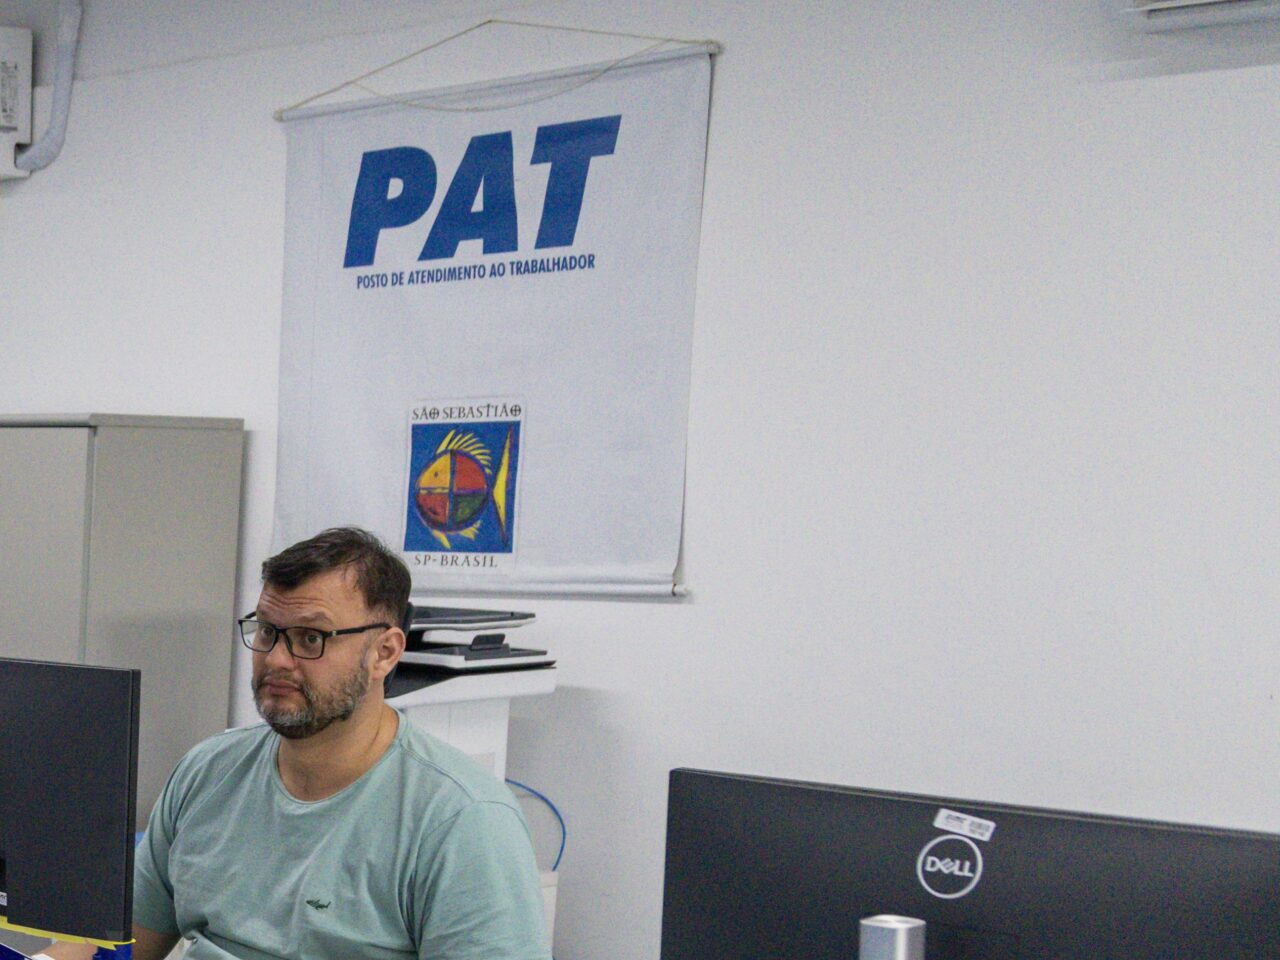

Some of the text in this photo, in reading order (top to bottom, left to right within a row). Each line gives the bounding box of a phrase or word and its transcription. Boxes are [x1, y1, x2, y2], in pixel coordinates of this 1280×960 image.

[343, 115, 622, 268] PAT
[356, 254, 595, 289] POSTO DE ATENDIMENTO AO TRABALHADOR
[442, 403, 522, 419] SEBASTIÃO
[925, 856, 974, 877] DELL
